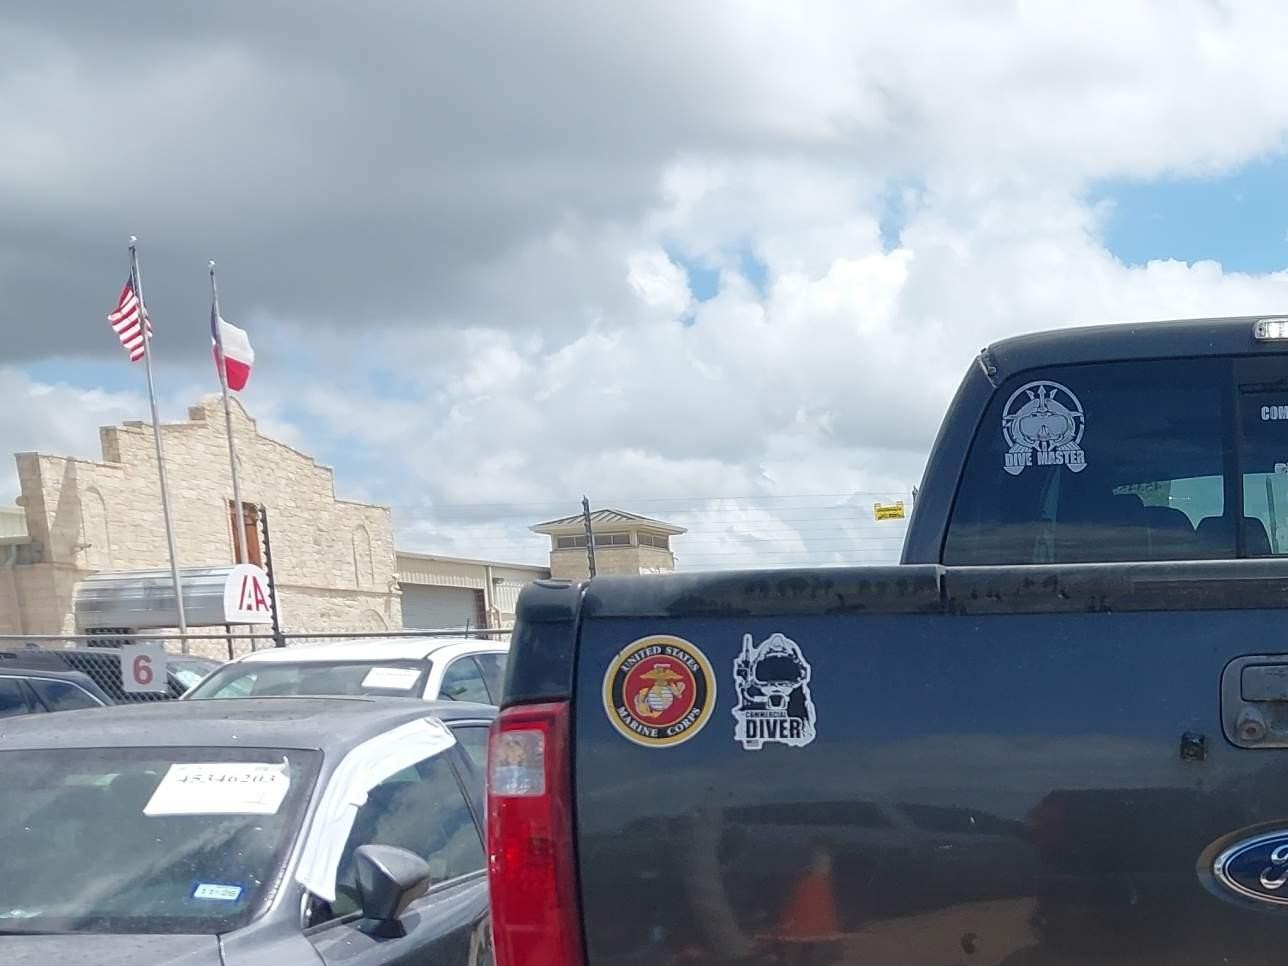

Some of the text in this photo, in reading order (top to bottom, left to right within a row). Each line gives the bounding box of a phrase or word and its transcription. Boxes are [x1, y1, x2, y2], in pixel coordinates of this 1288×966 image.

[1005, 450, 1085, 466] DIVE MASTER
[133, 655, 153, 685] 6
[621, 646, 700, 672] UNITED STATES
[616, 706, 701, 737] MARINE CORPS
[746, 719, 801, 738] DIVER
